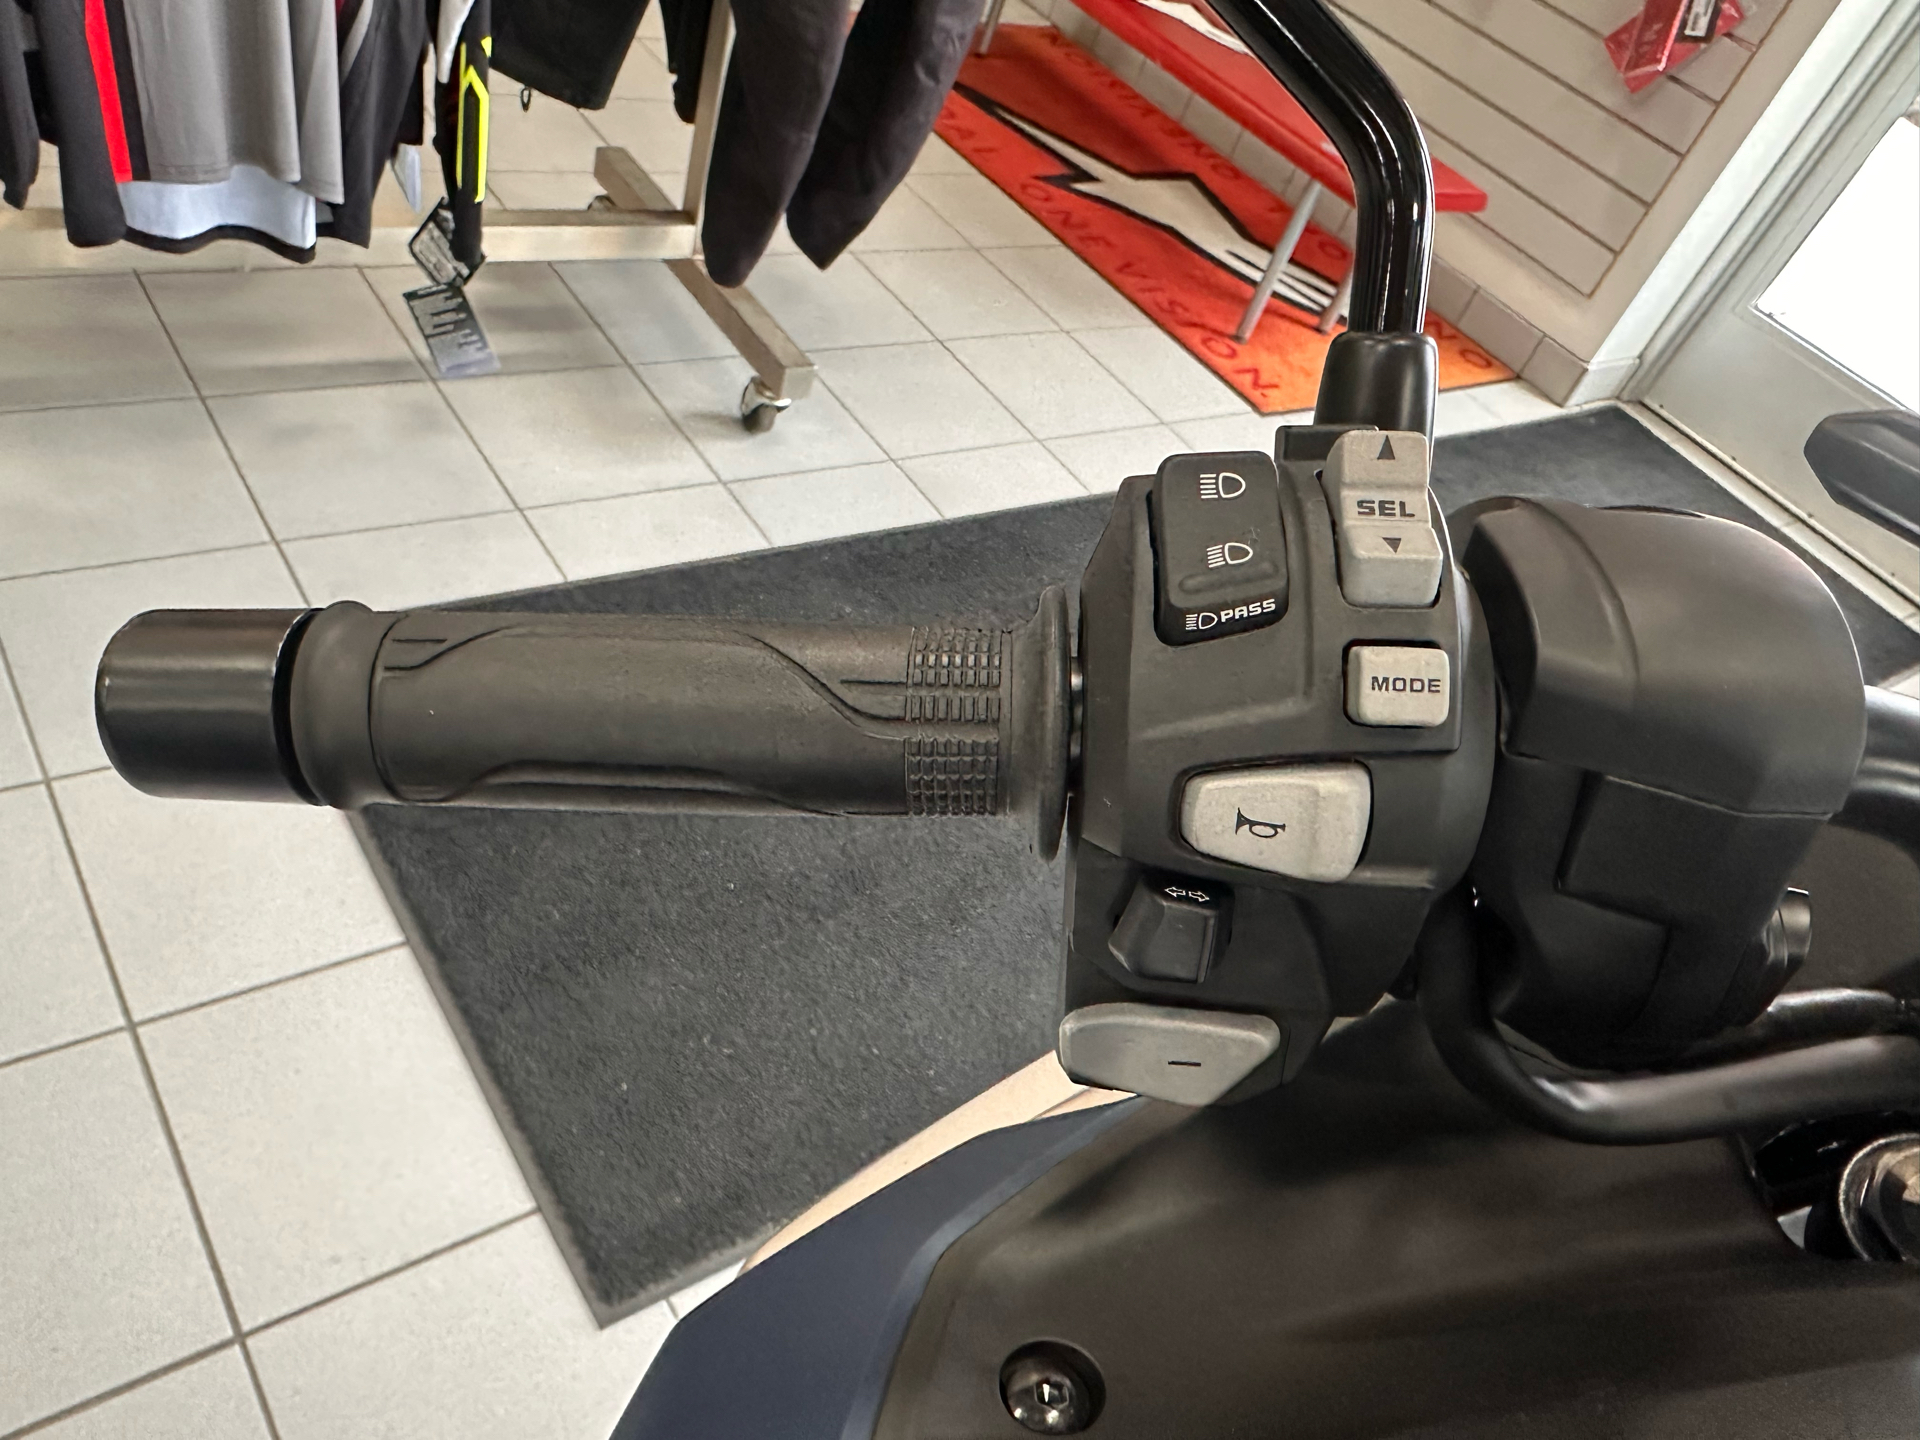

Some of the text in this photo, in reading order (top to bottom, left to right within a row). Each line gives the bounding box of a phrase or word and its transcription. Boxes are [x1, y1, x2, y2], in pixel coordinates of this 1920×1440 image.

[1356, 500, 1416, 517] SEL
[1220, 598, 1276, 623] PASS
[1371, 676, 1441, 693] MODE
